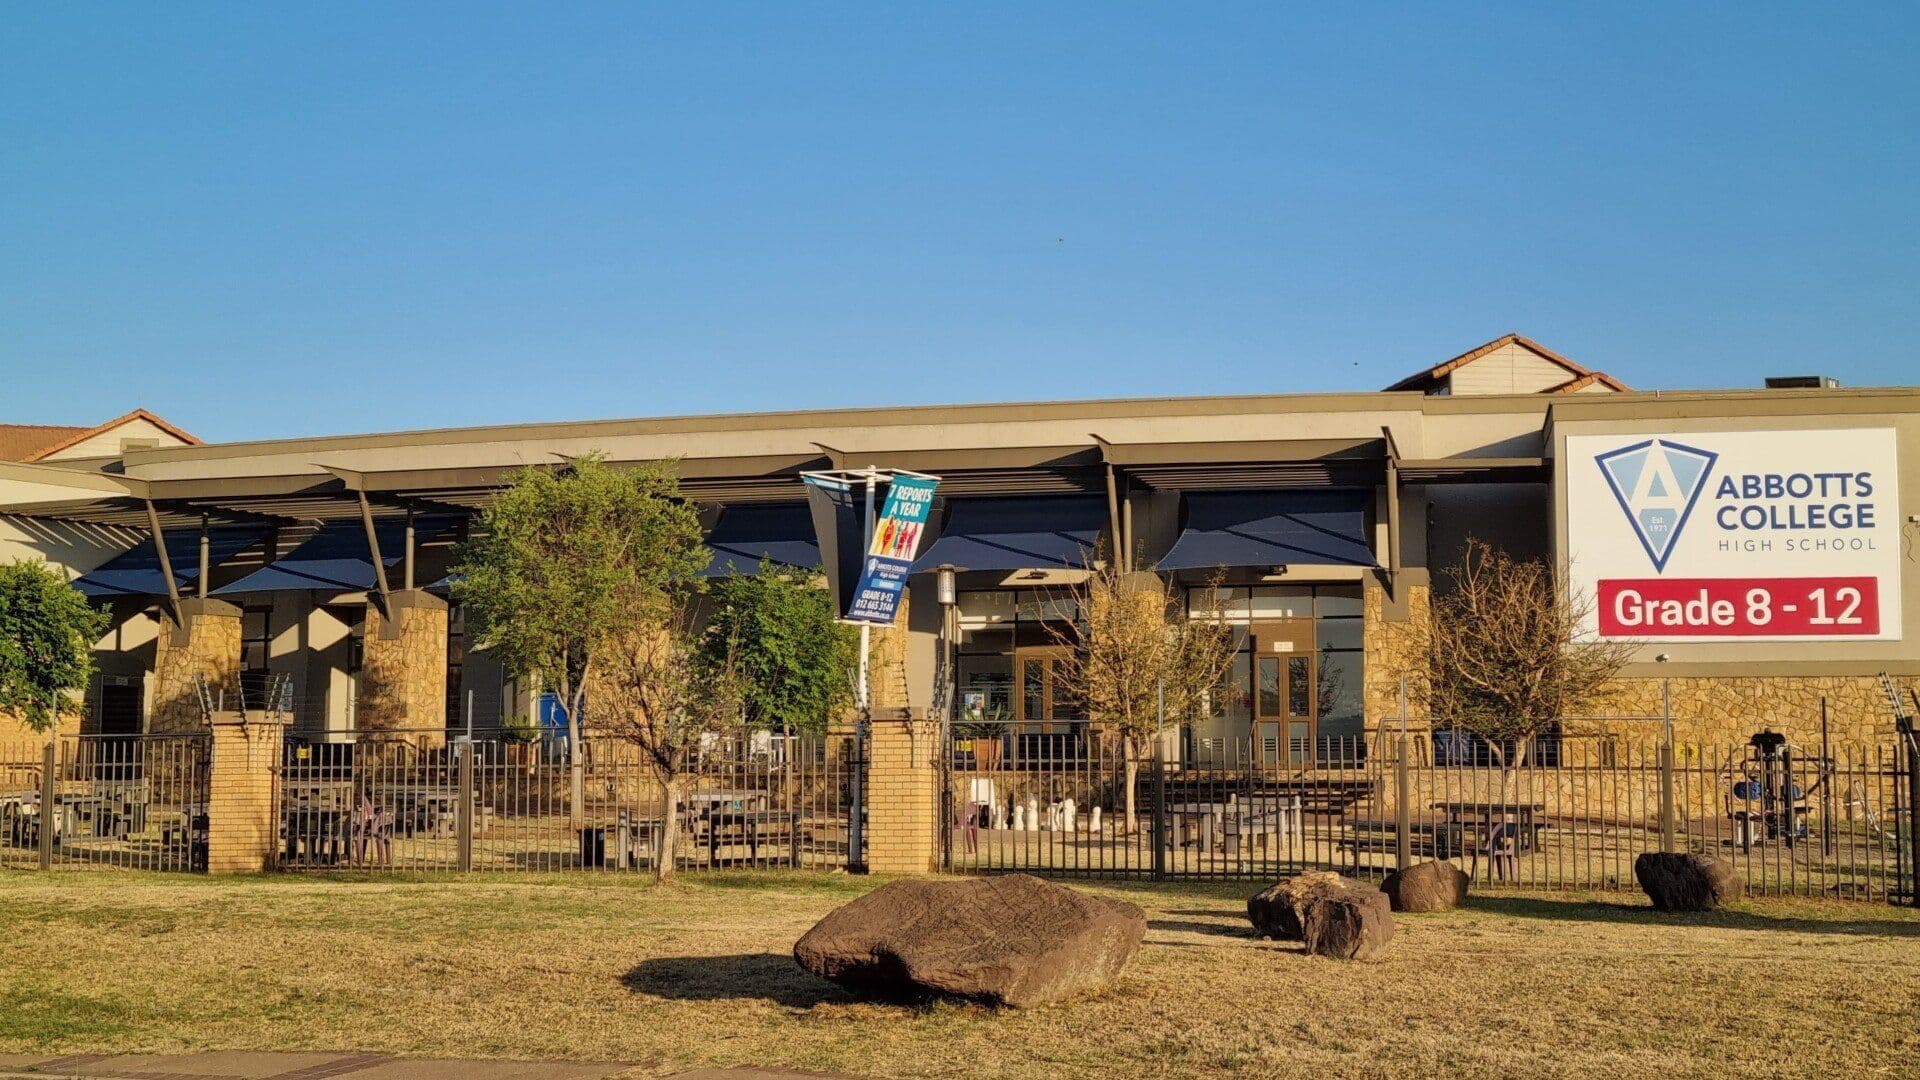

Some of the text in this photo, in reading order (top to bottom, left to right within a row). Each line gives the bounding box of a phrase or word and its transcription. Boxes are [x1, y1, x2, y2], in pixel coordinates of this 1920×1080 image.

[888, 484, 934, 503] 7 REPORTS
[1715, 472, 1873, 500] ABBOTTS
[890, 500, 922, 517] A YEAR
[1716, 503, 1876, 531] COLLEGE
[1718, 538, 1876, 552] HIGH SCHOOL
[855, 599, 868, 609] 012
[861, 590, 894, 602] GRADE 8-12
[1614, 588, 1735, 626] Grade
[1745, 587, 1772, 626] 8
[1807, 587, 1863, 625] 12
